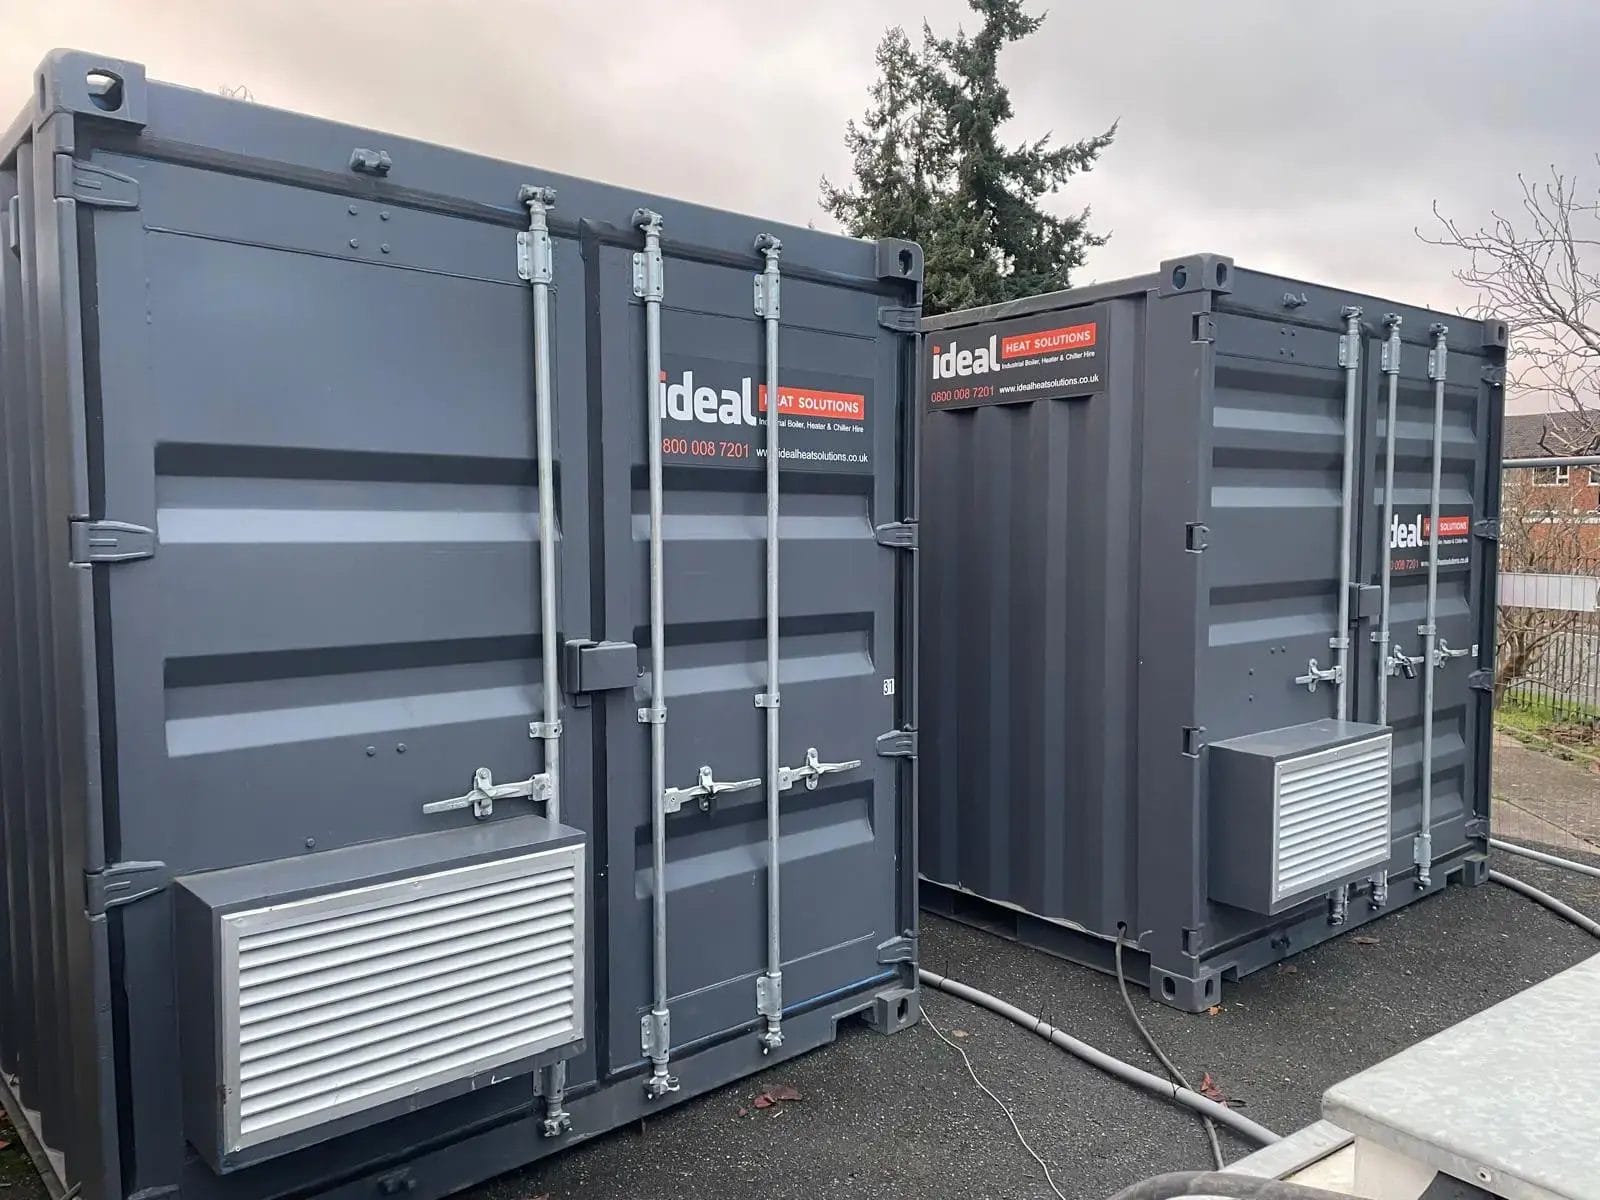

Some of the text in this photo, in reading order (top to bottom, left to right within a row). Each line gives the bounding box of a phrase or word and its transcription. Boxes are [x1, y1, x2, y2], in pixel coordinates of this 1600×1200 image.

[1006, 331, 1091, 353] HEAT SOLUTIONS
[933, 335, 1000, 379] ideal
[1065, 352, 1083, 360] Chiller
[931, 385, 994, 403] 0800 008 7201
[999, 374, 1099, 394] www.idealheatsolutions.co.uk
[659, 371, 757, 426] ideal
[798, 397, 859, 413] SOLUTIONS
[787, 420, 806, 430] Boiler,
[806, 422, 825, 430] Heater
[826, 422, 832, 431] &
[833, 423, 851, 432] Chiller
[852, 425, 864, 433] Hire
[662, 438, 749, 458] 800 008 7201
[1390, 514, 1423, 548] deal
[884, 680, 894, 694] 31
